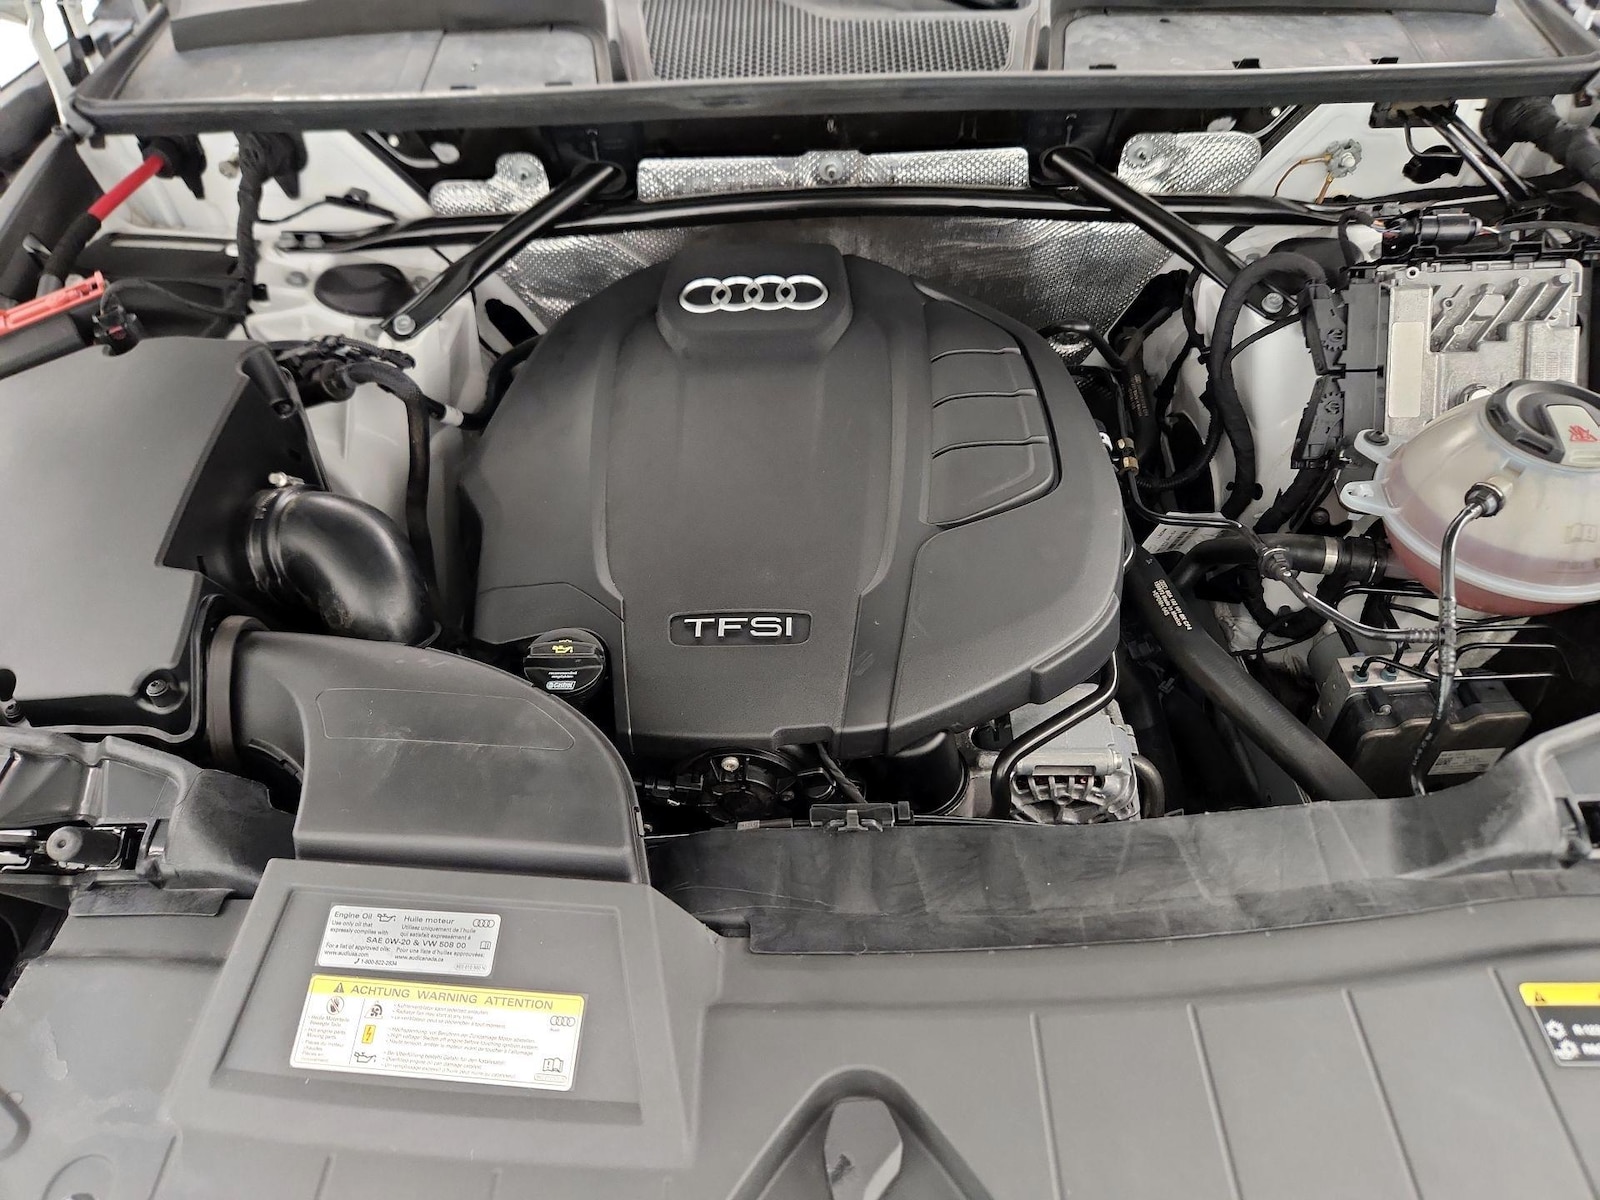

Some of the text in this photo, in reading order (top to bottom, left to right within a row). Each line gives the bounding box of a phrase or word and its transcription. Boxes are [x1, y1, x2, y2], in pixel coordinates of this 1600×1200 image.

[683, 616, 793, 638] TFSI
[334, 911, 373, 920] Engine Oil
[403, 915, 423, 923] Huile
[420, 925, 452, 933] uniquement
[366, 936, 383, 944] SAE
[384, 937, 411, 946] 0W-20
[422, 940, 438, 948] VW
[439, 941, 455, 949] 508
[323, 950, 369, 958] www.audiusa.com
[350, 985, 554, 1010] ACHTUNG WARNING ATTENTION
